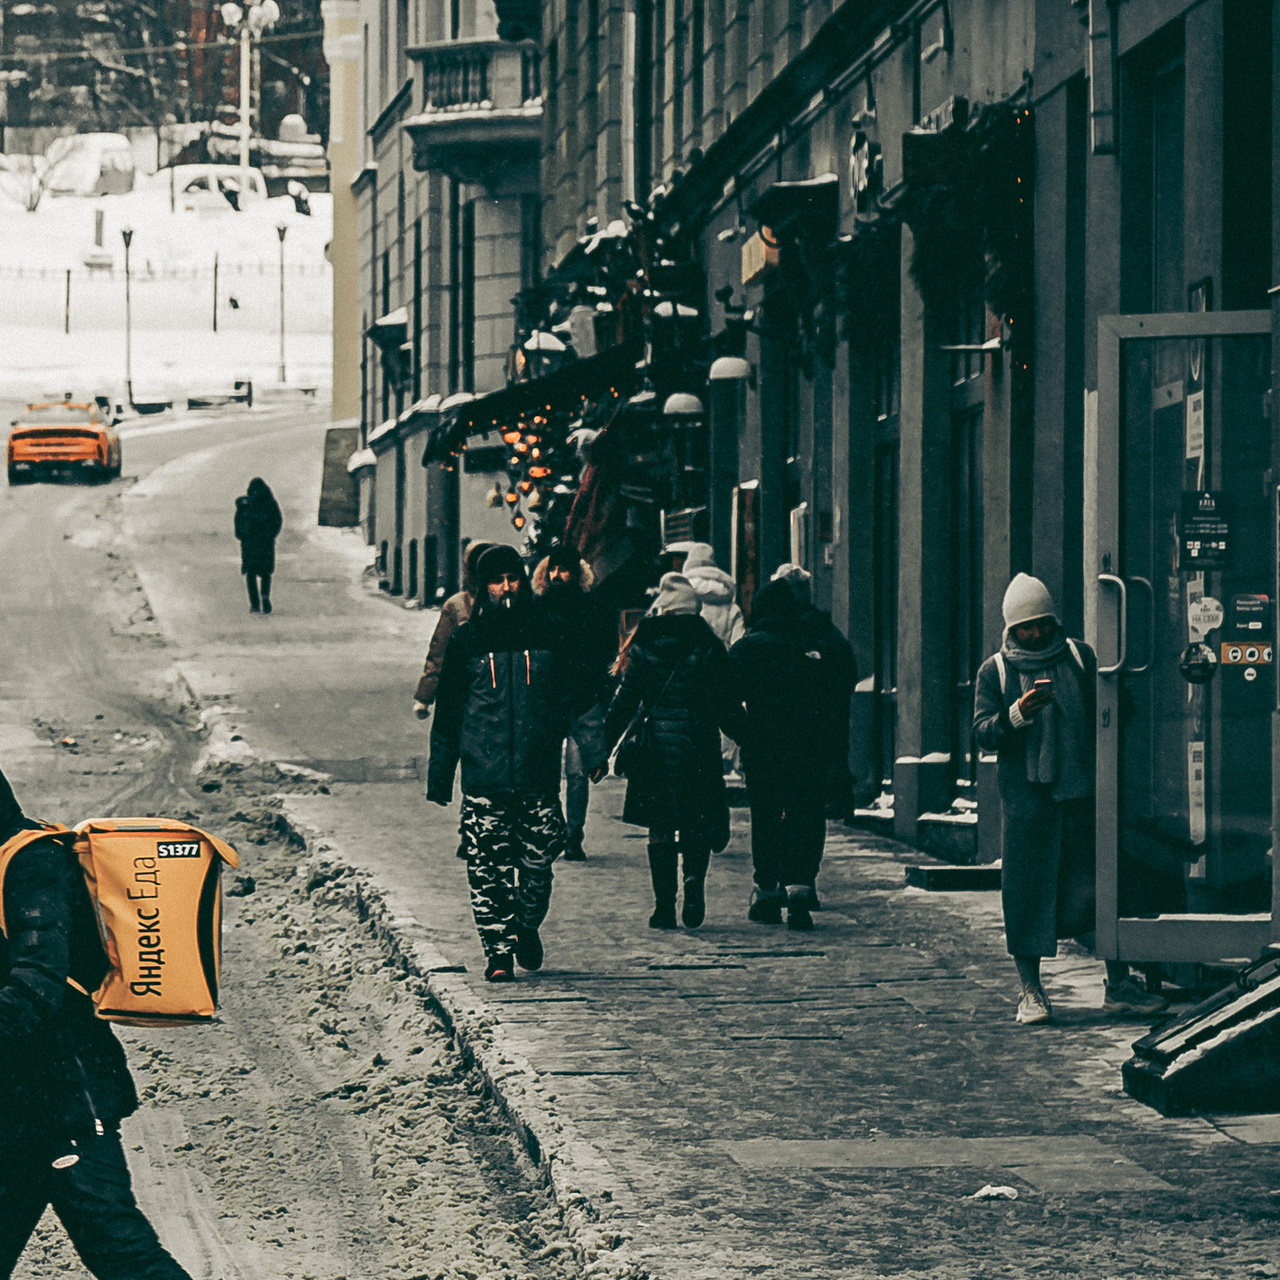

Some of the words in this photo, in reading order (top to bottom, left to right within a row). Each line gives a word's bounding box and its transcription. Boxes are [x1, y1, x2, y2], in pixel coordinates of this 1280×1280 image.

[157, 843, 199, 858] S1377
[126, 856, 162, 900] Еда
[129, 907, 166, 997] Яндекс
